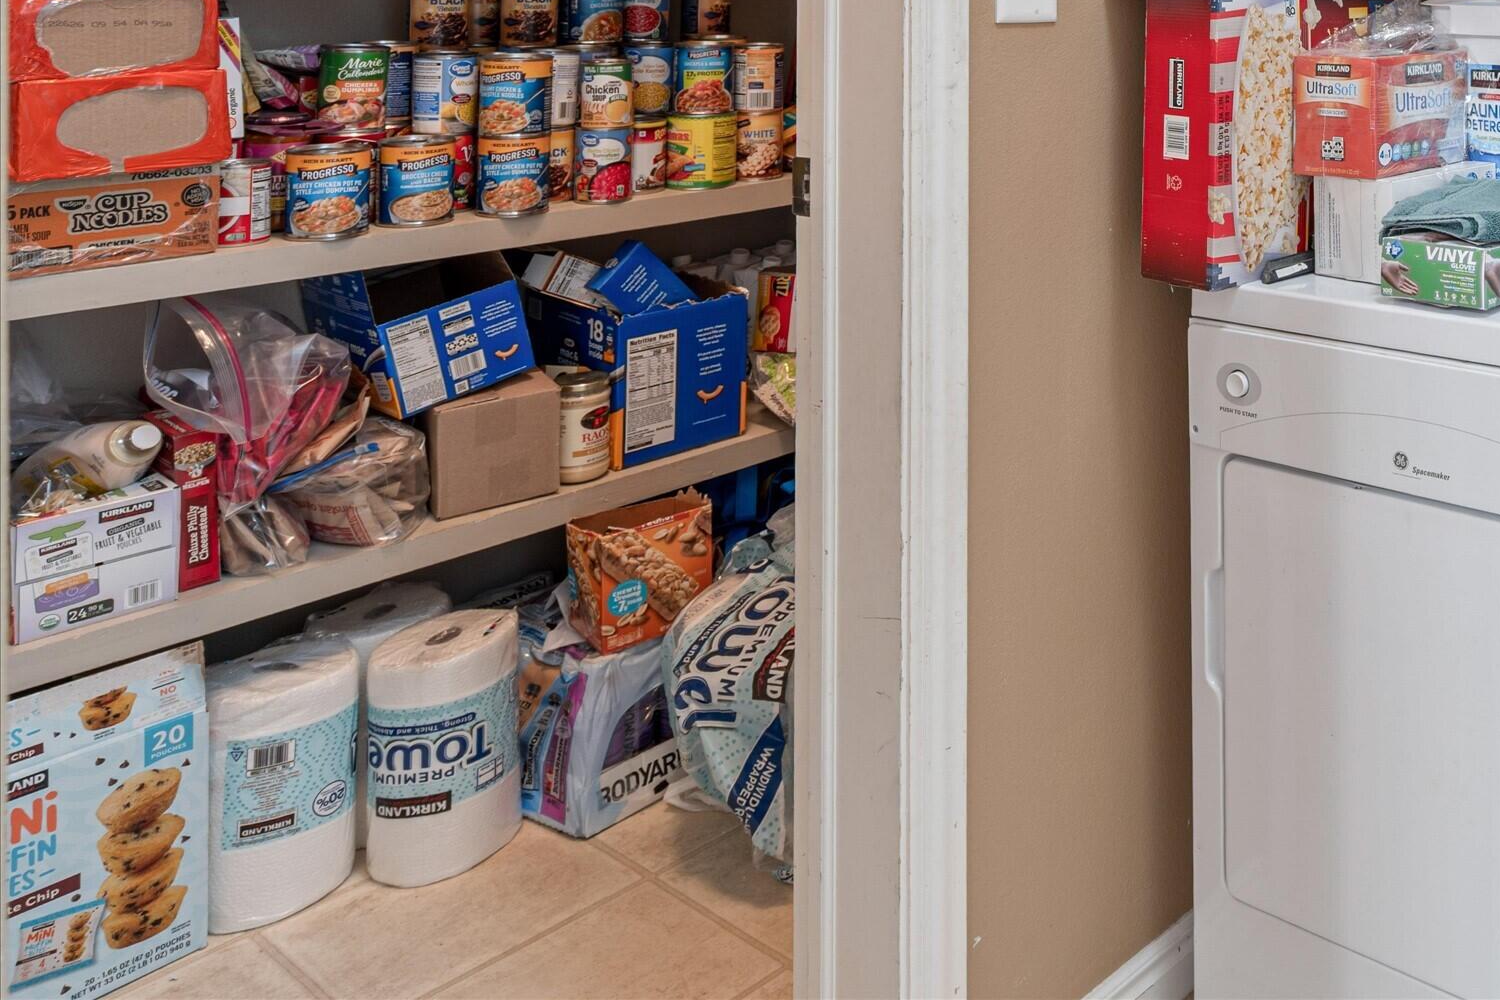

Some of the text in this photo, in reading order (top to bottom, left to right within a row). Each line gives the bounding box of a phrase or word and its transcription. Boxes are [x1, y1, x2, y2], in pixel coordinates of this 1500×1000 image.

[339, 57, 384, 71] Marie
[1317, 64, 1350, 73] KIRKLAND
[1407, 63, 1443, 76] KIRKLAND
[585, 84, 619, 95] Chicken
[1176, 62, 1184, 107] KIRKLAND
[1306, 81, 1357, 96] UltraSoft
[228, 87, 237, 115] organic
[743, 129, 775, 139] WHITE
[401, 155, 448, 171] PROGRESSO
[491, 149, 537, 163] PROGRESSO
[301, 163, 354, 181] PROGRESSO
[96, 192, 151, 212] CUP
[20, 205, 50, 219] PACK
[71, 205, 167, 233] NOODLES
[1425, 245, 1477, 265] VINYL
[1450, 262, 1476, 271] GLOVES
[775, 276, 790, 298] RITZ
[587, 317, 605, 343] 18
[630, 332, 675, 347] Nutrition Facts
[1219, 406, 1234, 414] PUSH
[1242, 410, 1257, 419] START
[1412, 466, 1451, 481] Spacemaker
[101, 501, 153, 518] KIRKLAND
[95, 536, 116, 551] FRUIT
[126, 519, 162, 539] VEGETABLE
[108, 518, 144, 535] ORGANIC
[188, 505, 199, 564] Deluxe Philly
[199, 505, 209, 561] Cheesesteak
[40, 539, 77, 554] KIRKLAND
[67, 608, 87, 622] 24
[160, 685, 177, 697] NO
[152, 724, 186, 751] 20
[10, 749, 36, 762] Chip
[151, 742, 187, 759] POUCHES
[374, 766, 456, 785] PREMIUM
[739, 747, 775, 808] WRAPPED
[316, 786, 345, 809] 20%
[377, 799, 448, 817] KIRKLAND
[242, 818, 294, 837] KIRKLAND
[26, 888, 60, 907] Chip
[155, 931, 191, 952] POUCHES
